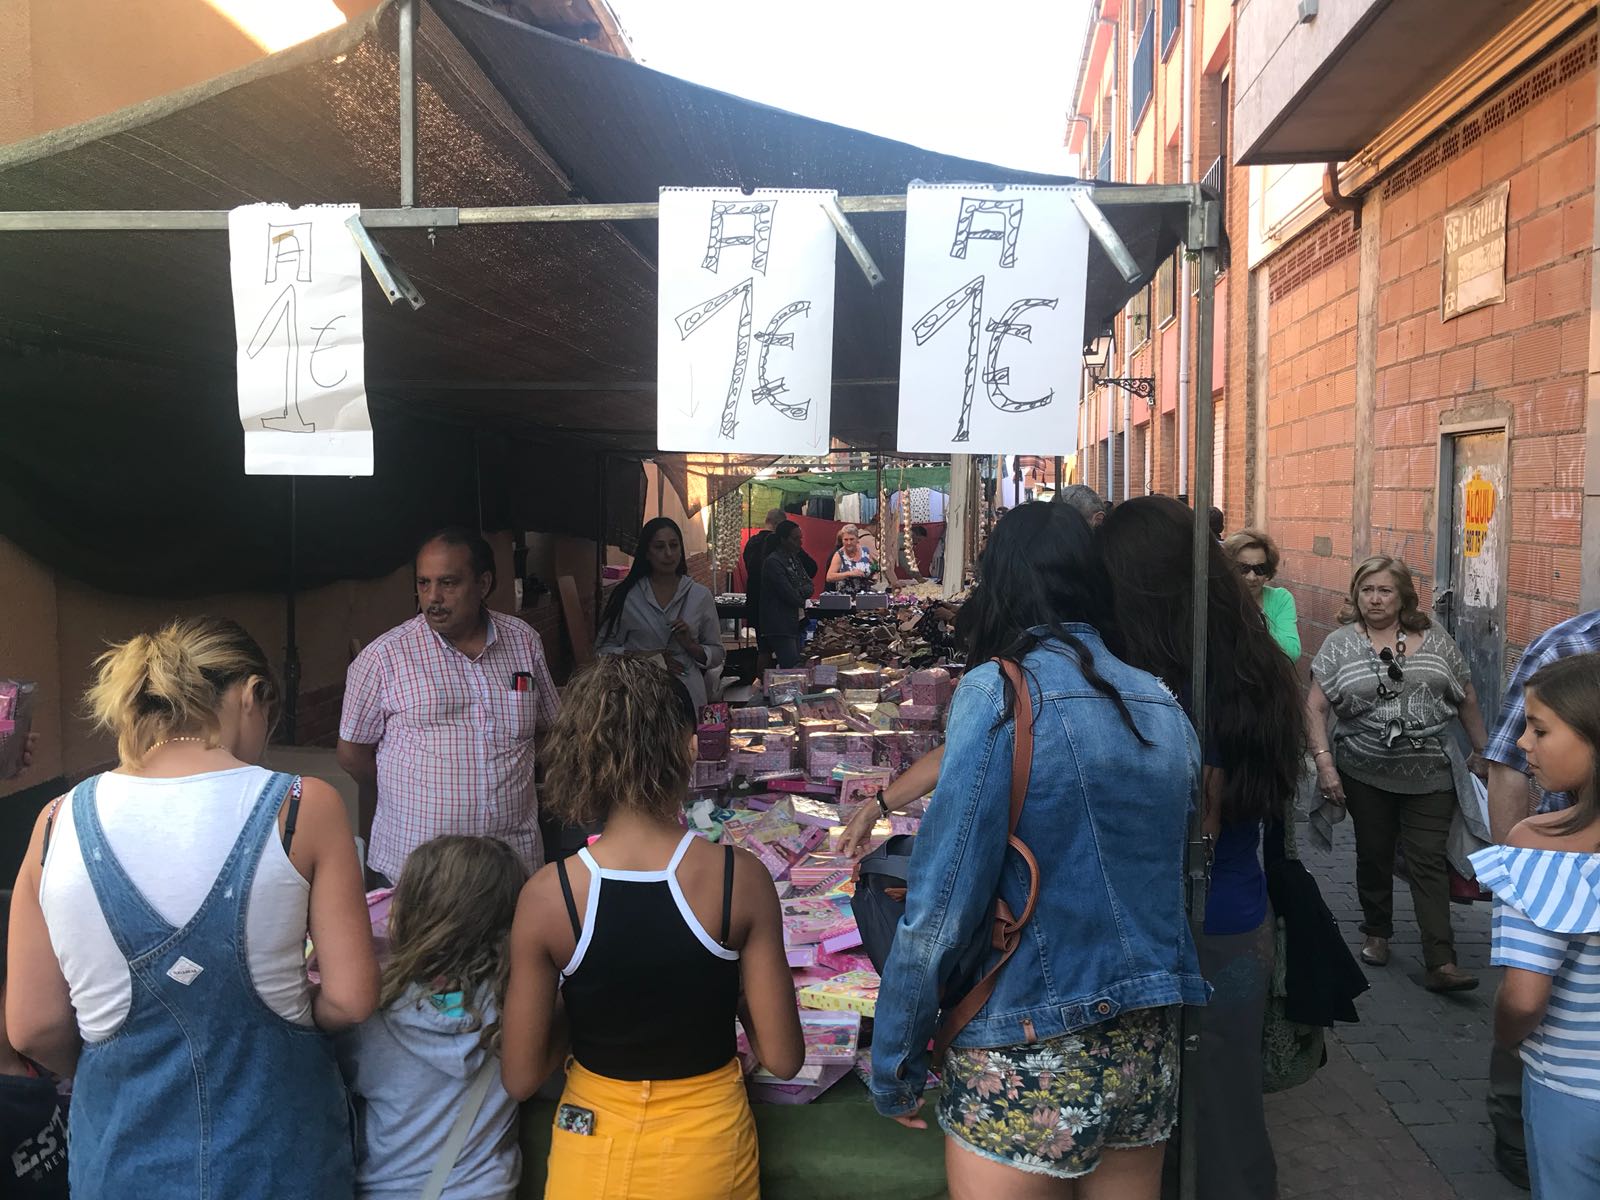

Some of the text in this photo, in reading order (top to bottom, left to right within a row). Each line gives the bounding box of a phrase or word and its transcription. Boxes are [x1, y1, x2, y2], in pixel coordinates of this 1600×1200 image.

[265, 222, 313, 285] A
[701, 199, 778, 276] A
[950, 197, 1024, 268] A
[1446, 196, 1505, 255] SE ALQUILA
